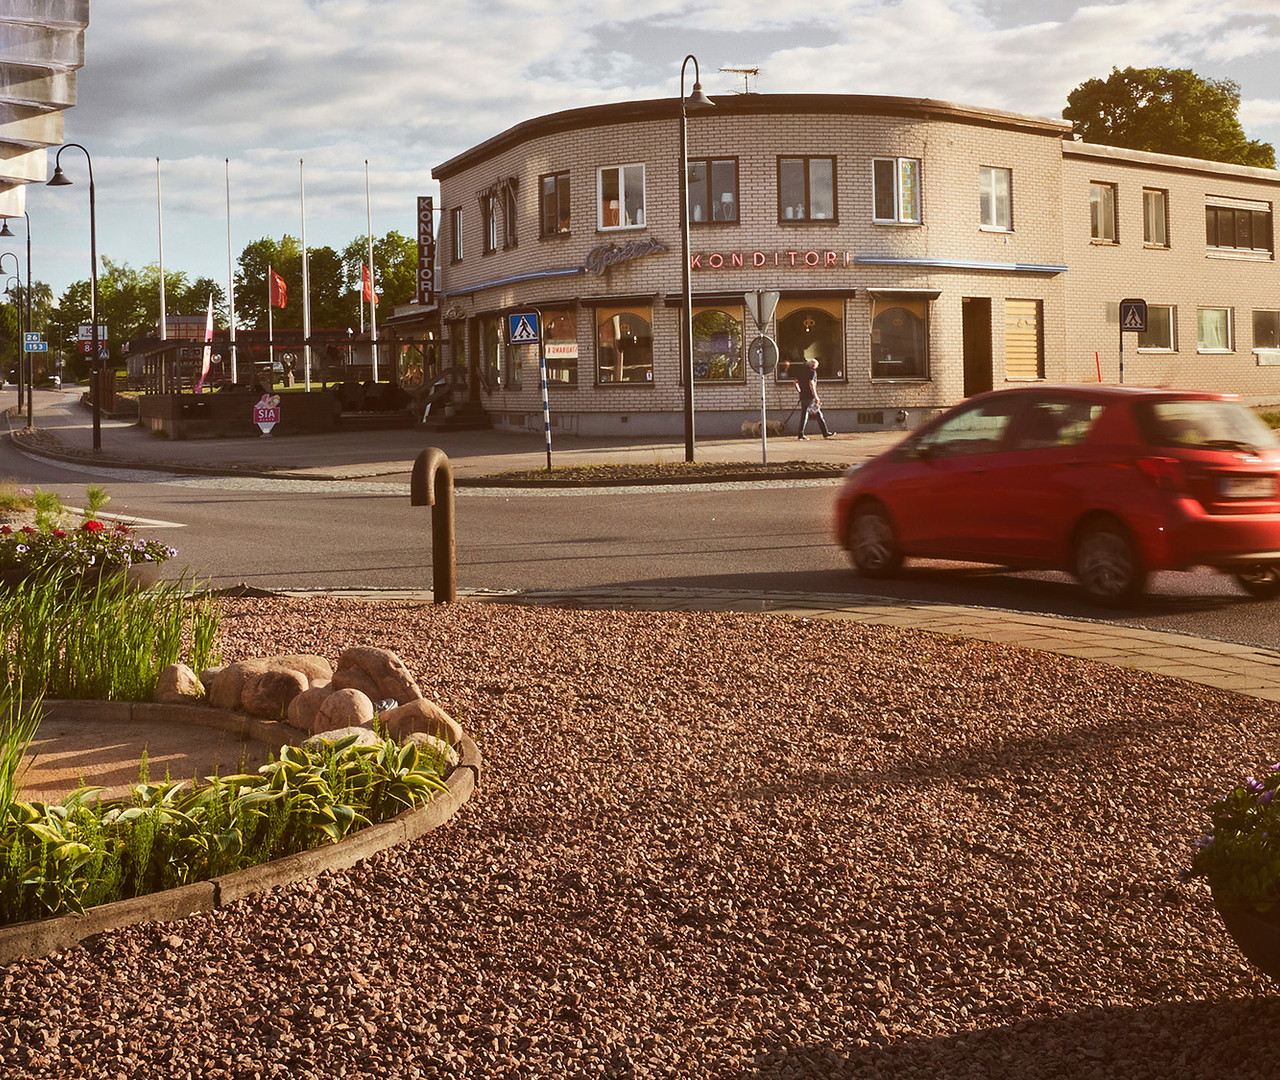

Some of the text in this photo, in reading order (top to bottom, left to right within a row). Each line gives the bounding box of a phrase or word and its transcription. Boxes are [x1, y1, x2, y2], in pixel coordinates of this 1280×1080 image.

[419, 199, 433, 303] KONDITORI
[690, 251, 851, 269] KONDITORI
[258, 410, 276, 418] SIA
